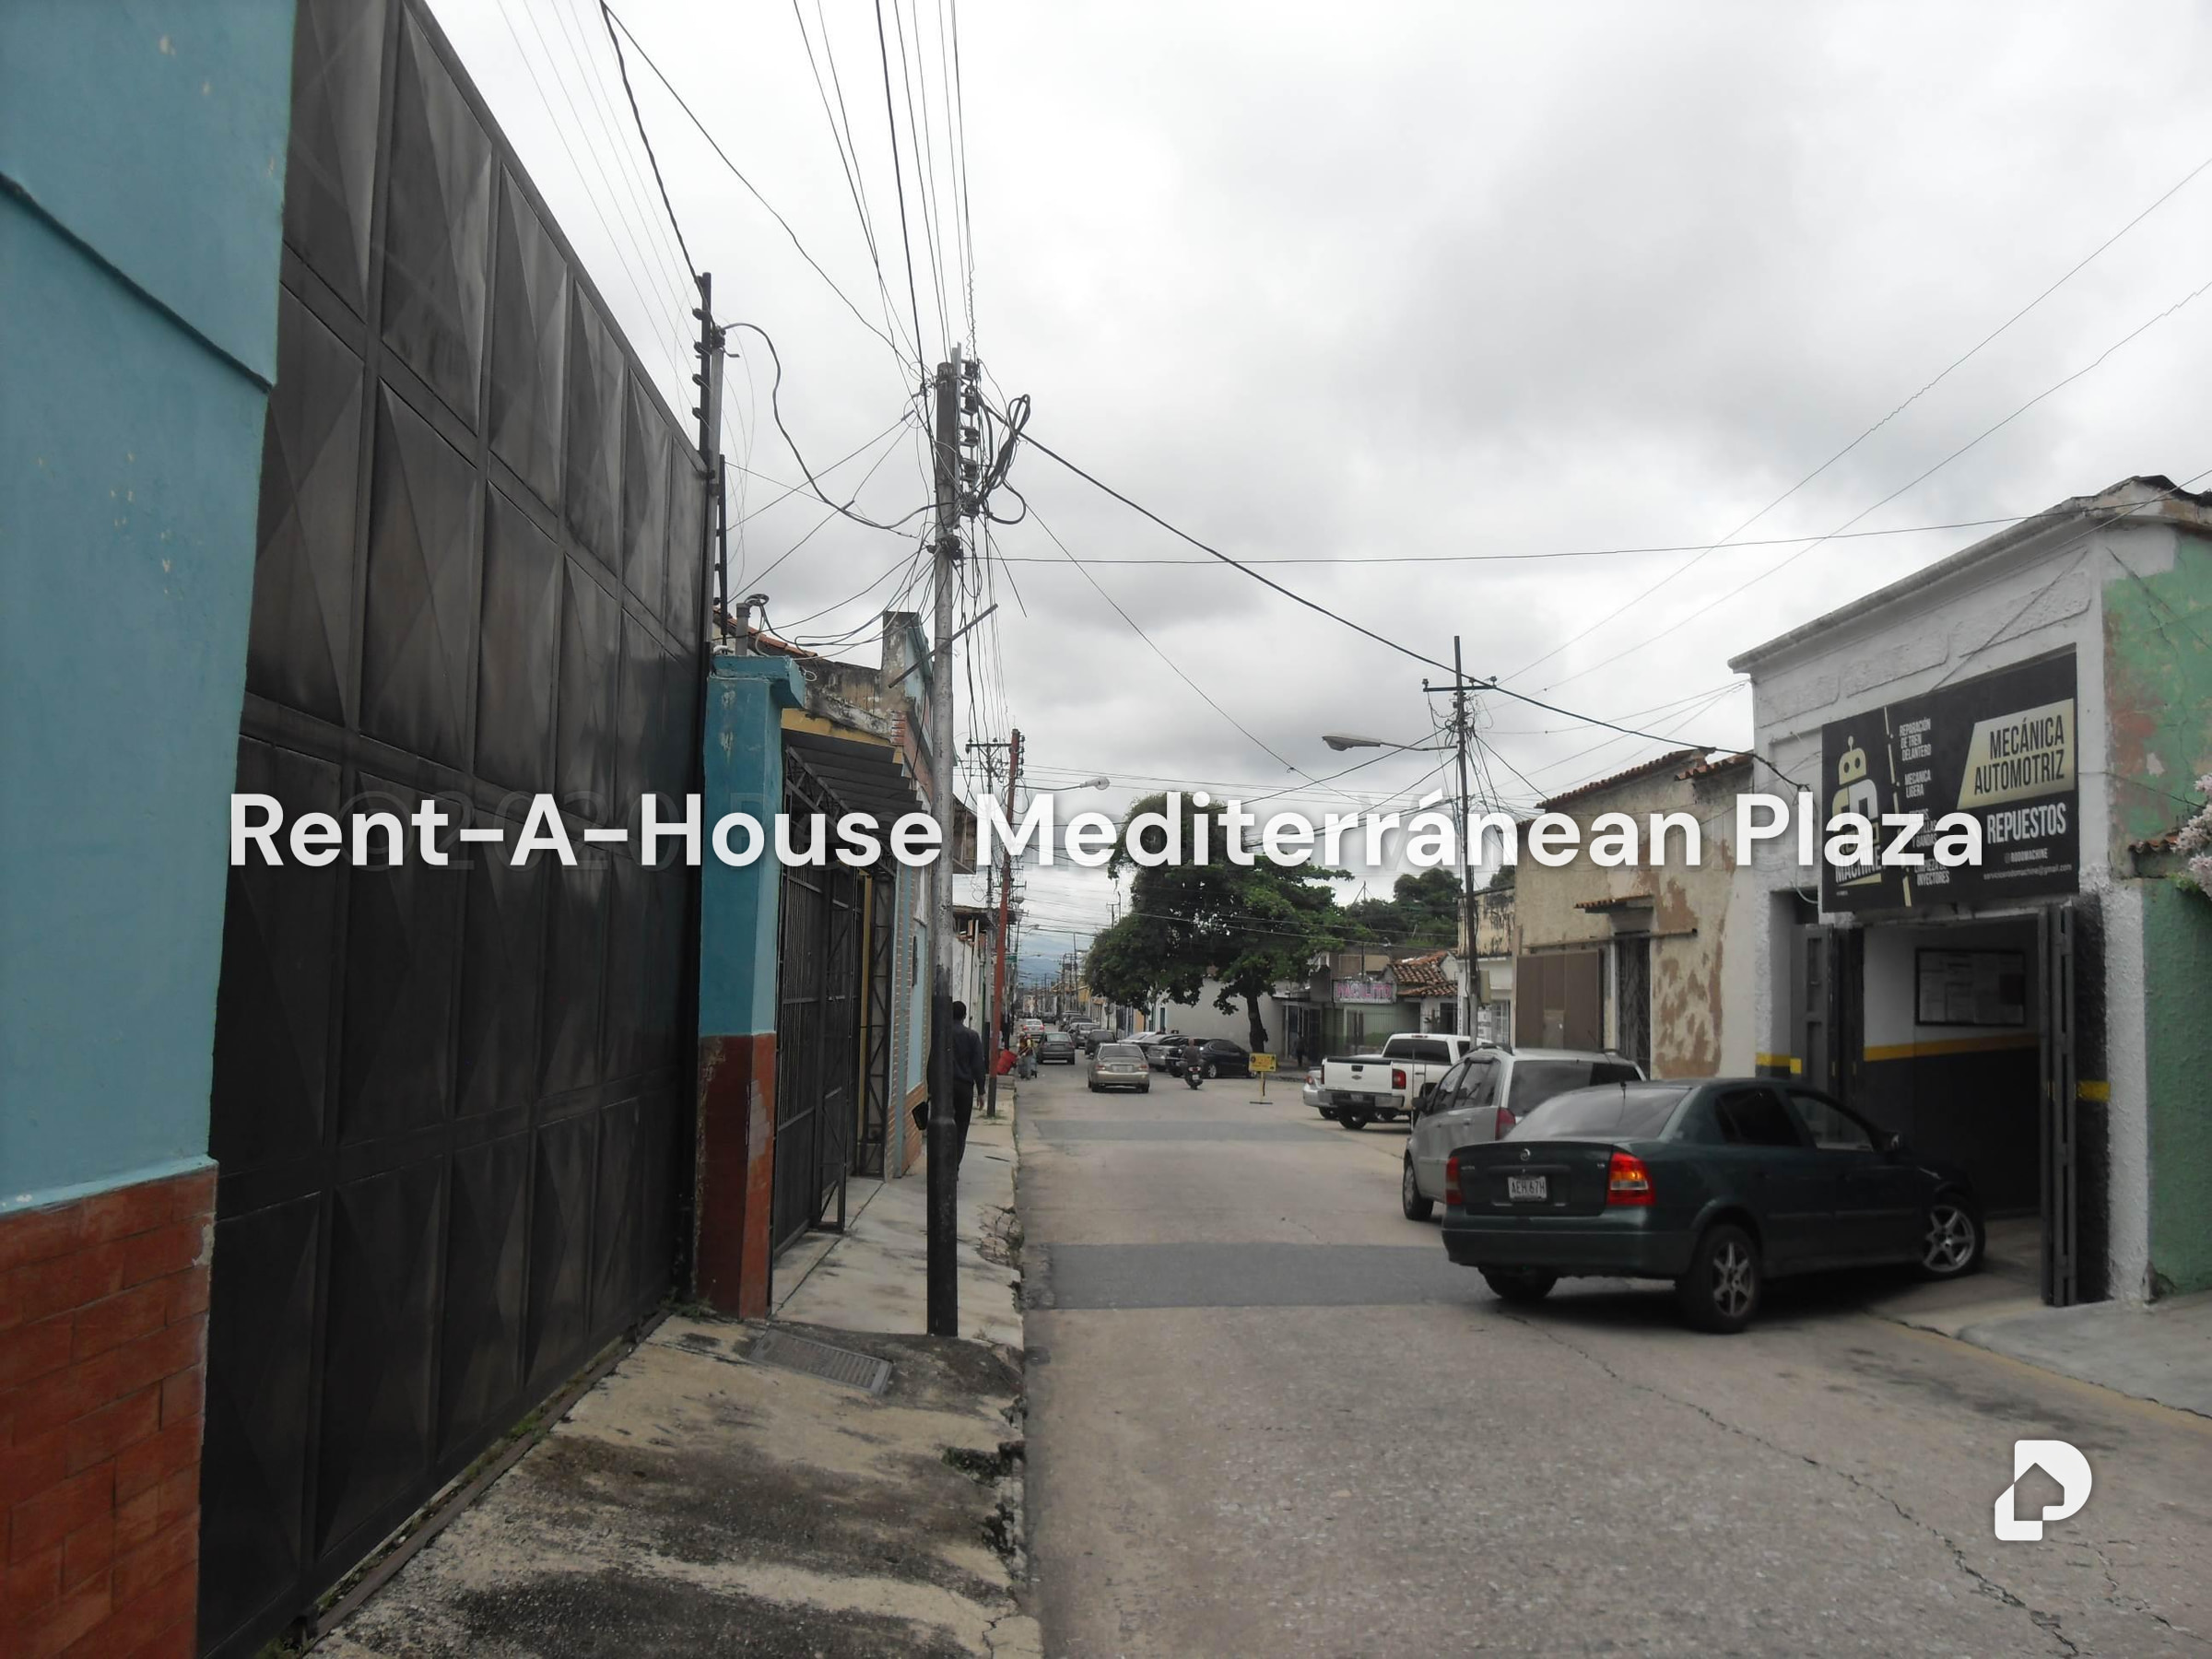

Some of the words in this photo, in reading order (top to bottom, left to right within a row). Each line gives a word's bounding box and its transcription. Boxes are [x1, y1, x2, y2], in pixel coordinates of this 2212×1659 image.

[1900, 736, 1909, 749] DE
[1909, 734, 1923, 747] TREN
[1990, 714, 2065, 760] MECÁNICA
[1901, 744, 1932, 761] DELANTERO
[1974, 749, 2065, 795] AUTOMOTRIZ
[1906, 783, 1924, 798] LIGERA
[1986, 802, 2066, 845] REPUESTOS
